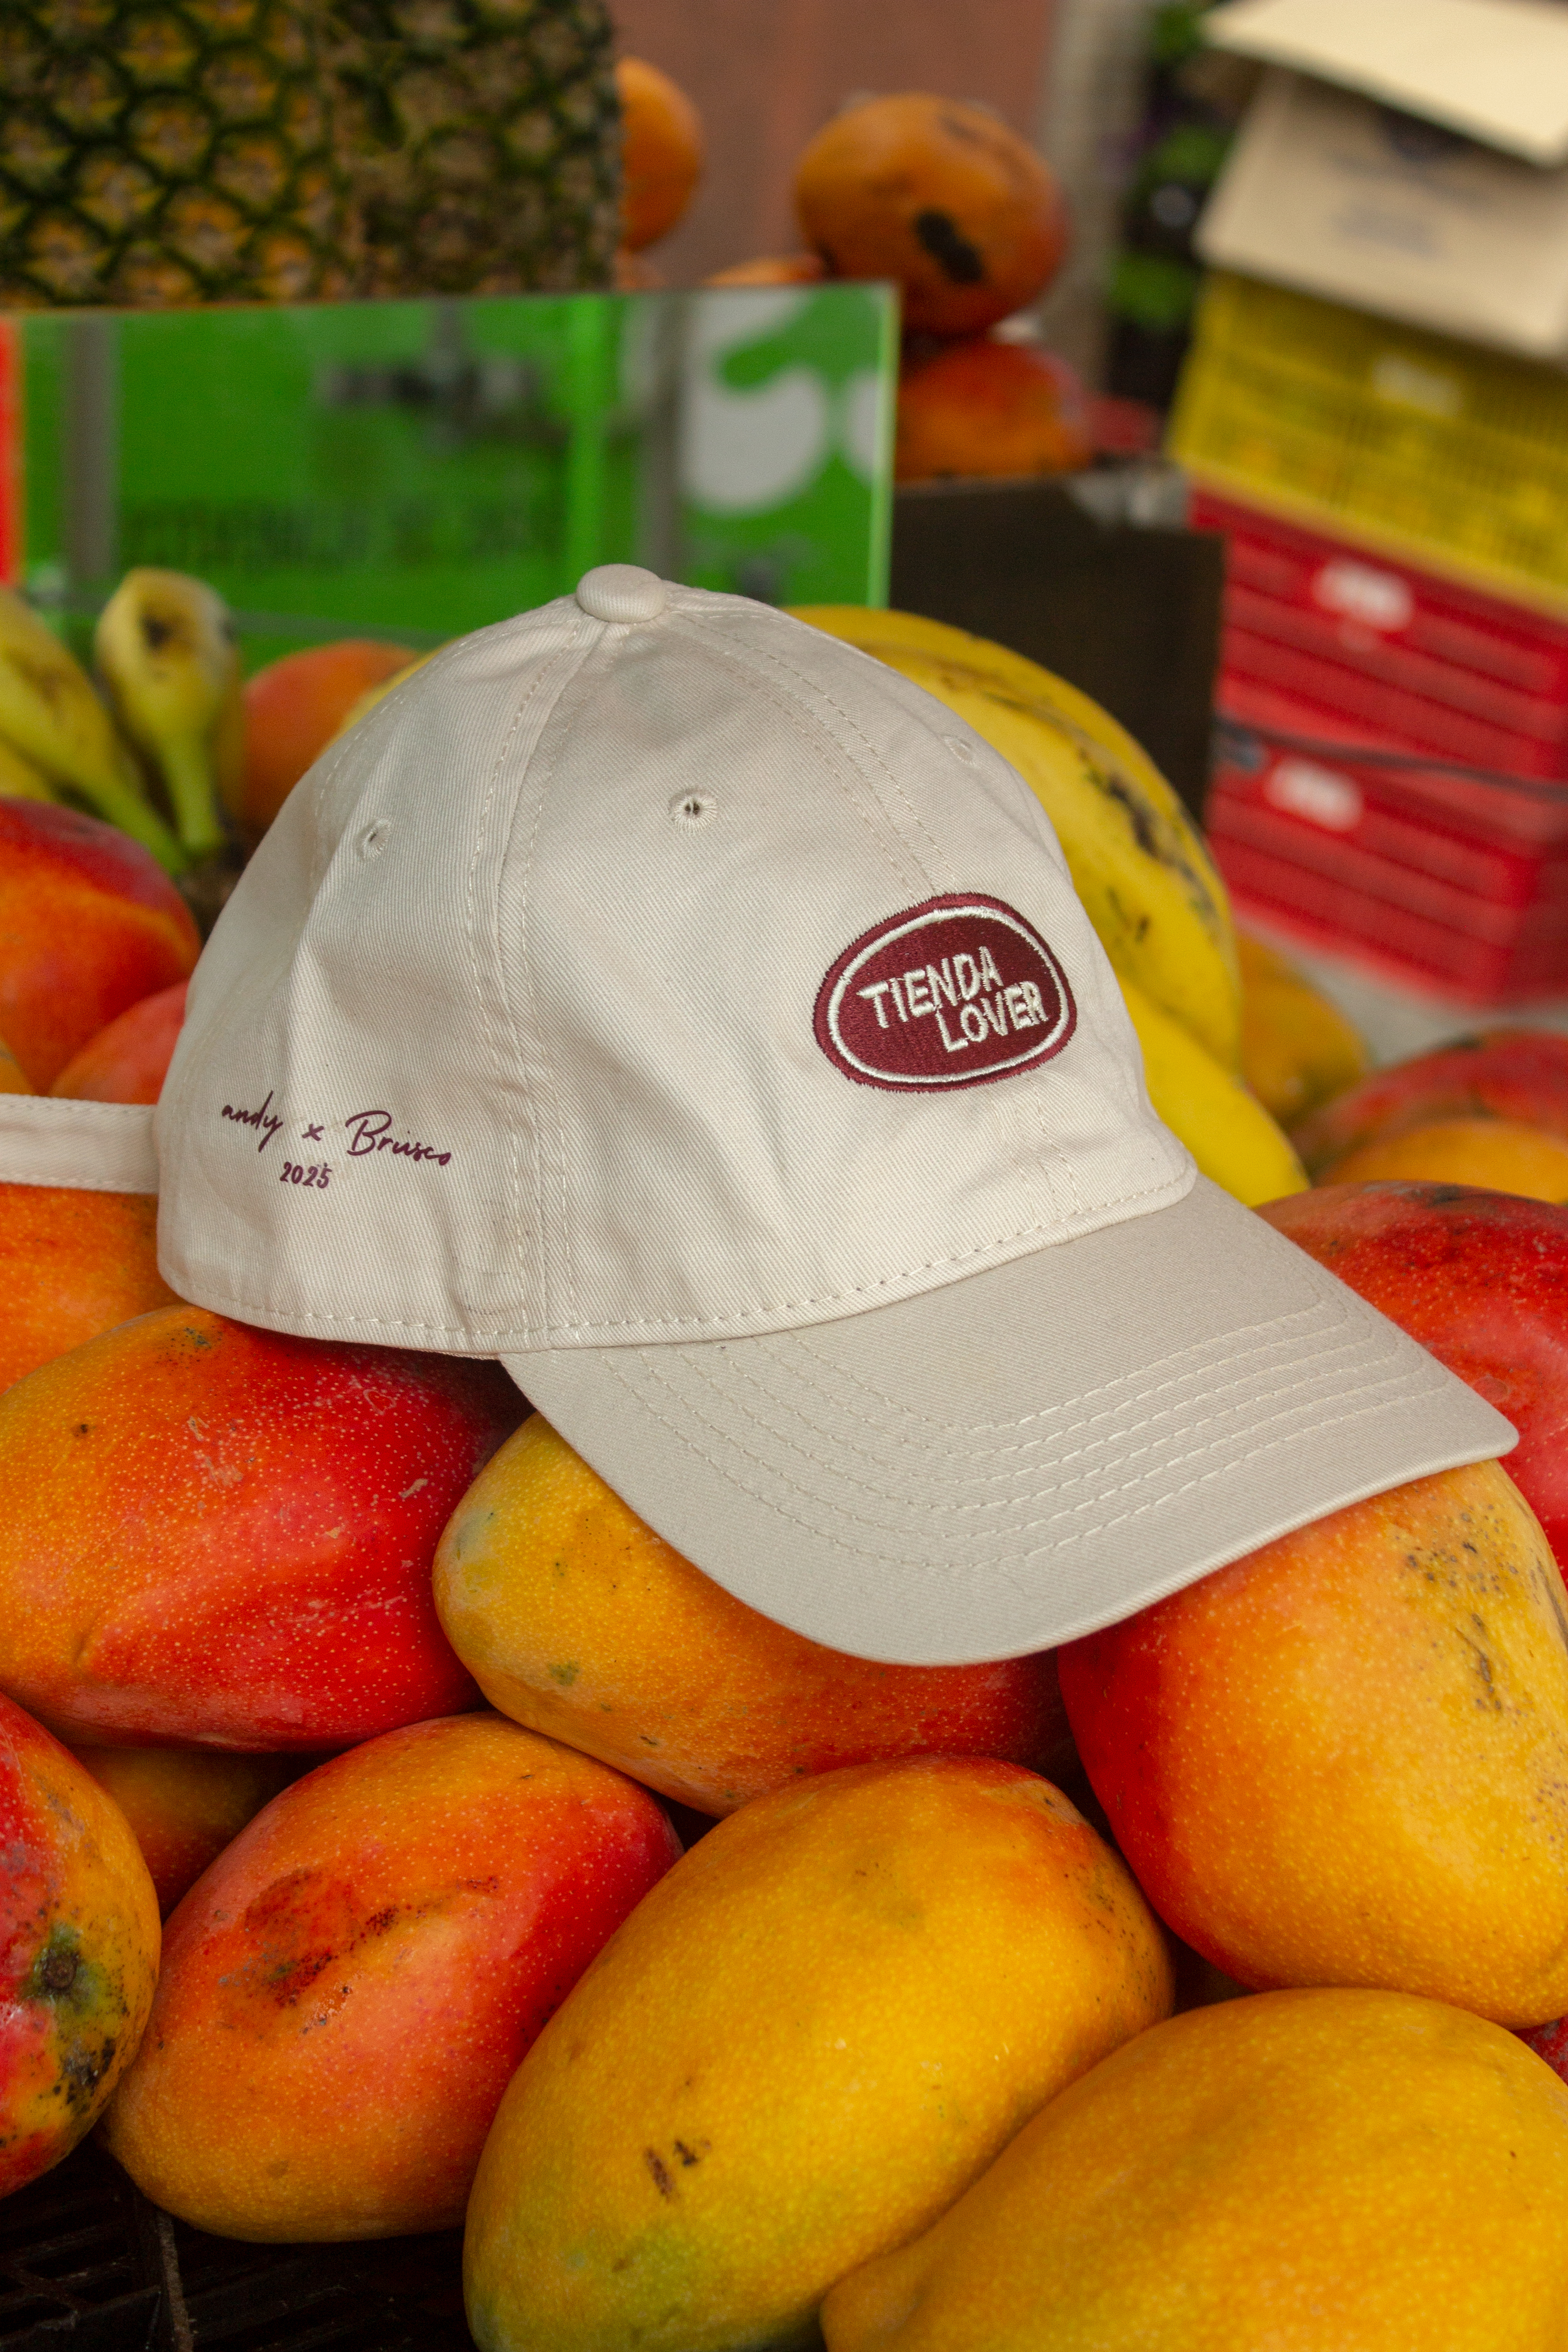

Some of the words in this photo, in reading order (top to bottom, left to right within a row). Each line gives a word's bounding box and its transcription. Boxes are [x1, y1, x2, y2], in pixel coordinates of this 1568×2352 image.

[856, 946, 1004, 1028] TIENDA
[935, 981, 1049, 1053] LOVER
[221, 1090, 284, 1153] andy
[302, 1124, 324, 1141] x
[280, 1162, 333, 1188] 2025
